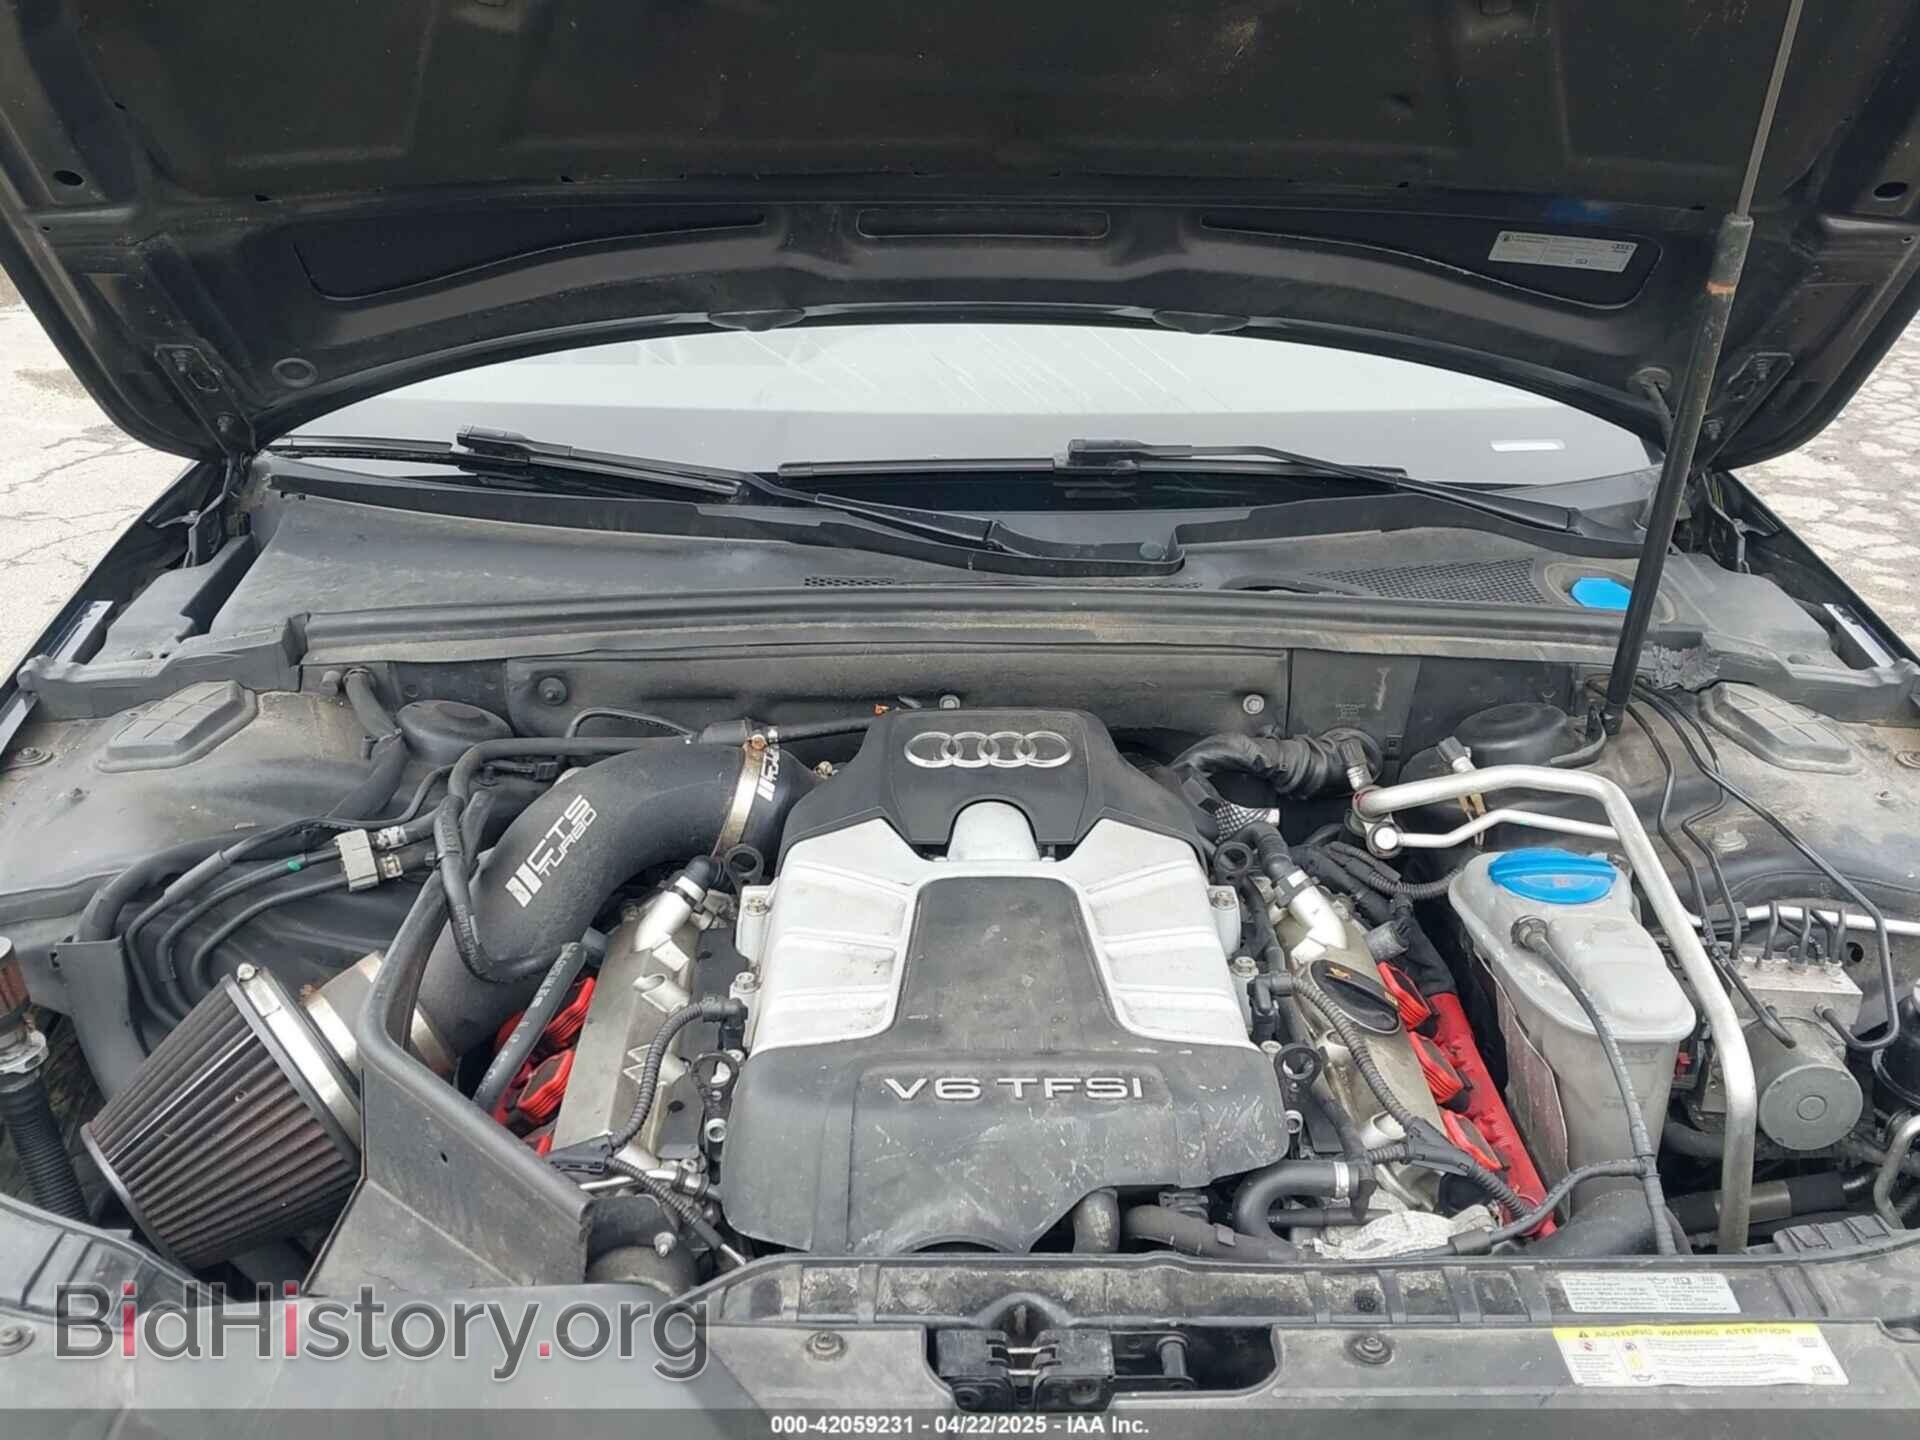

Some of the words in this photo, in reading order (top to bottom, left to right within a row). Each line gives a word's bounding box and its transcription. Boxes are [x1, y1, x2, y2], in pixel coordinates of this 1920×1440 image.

[526, 794, 590, 872] CTS
[538, 807, 597, 877] TURBO
[885, 1078, 981, 1100] V6
[997, 1077, 1143, 1099] TFSI
[1659, 1328, 1719, 1337] WARNING
